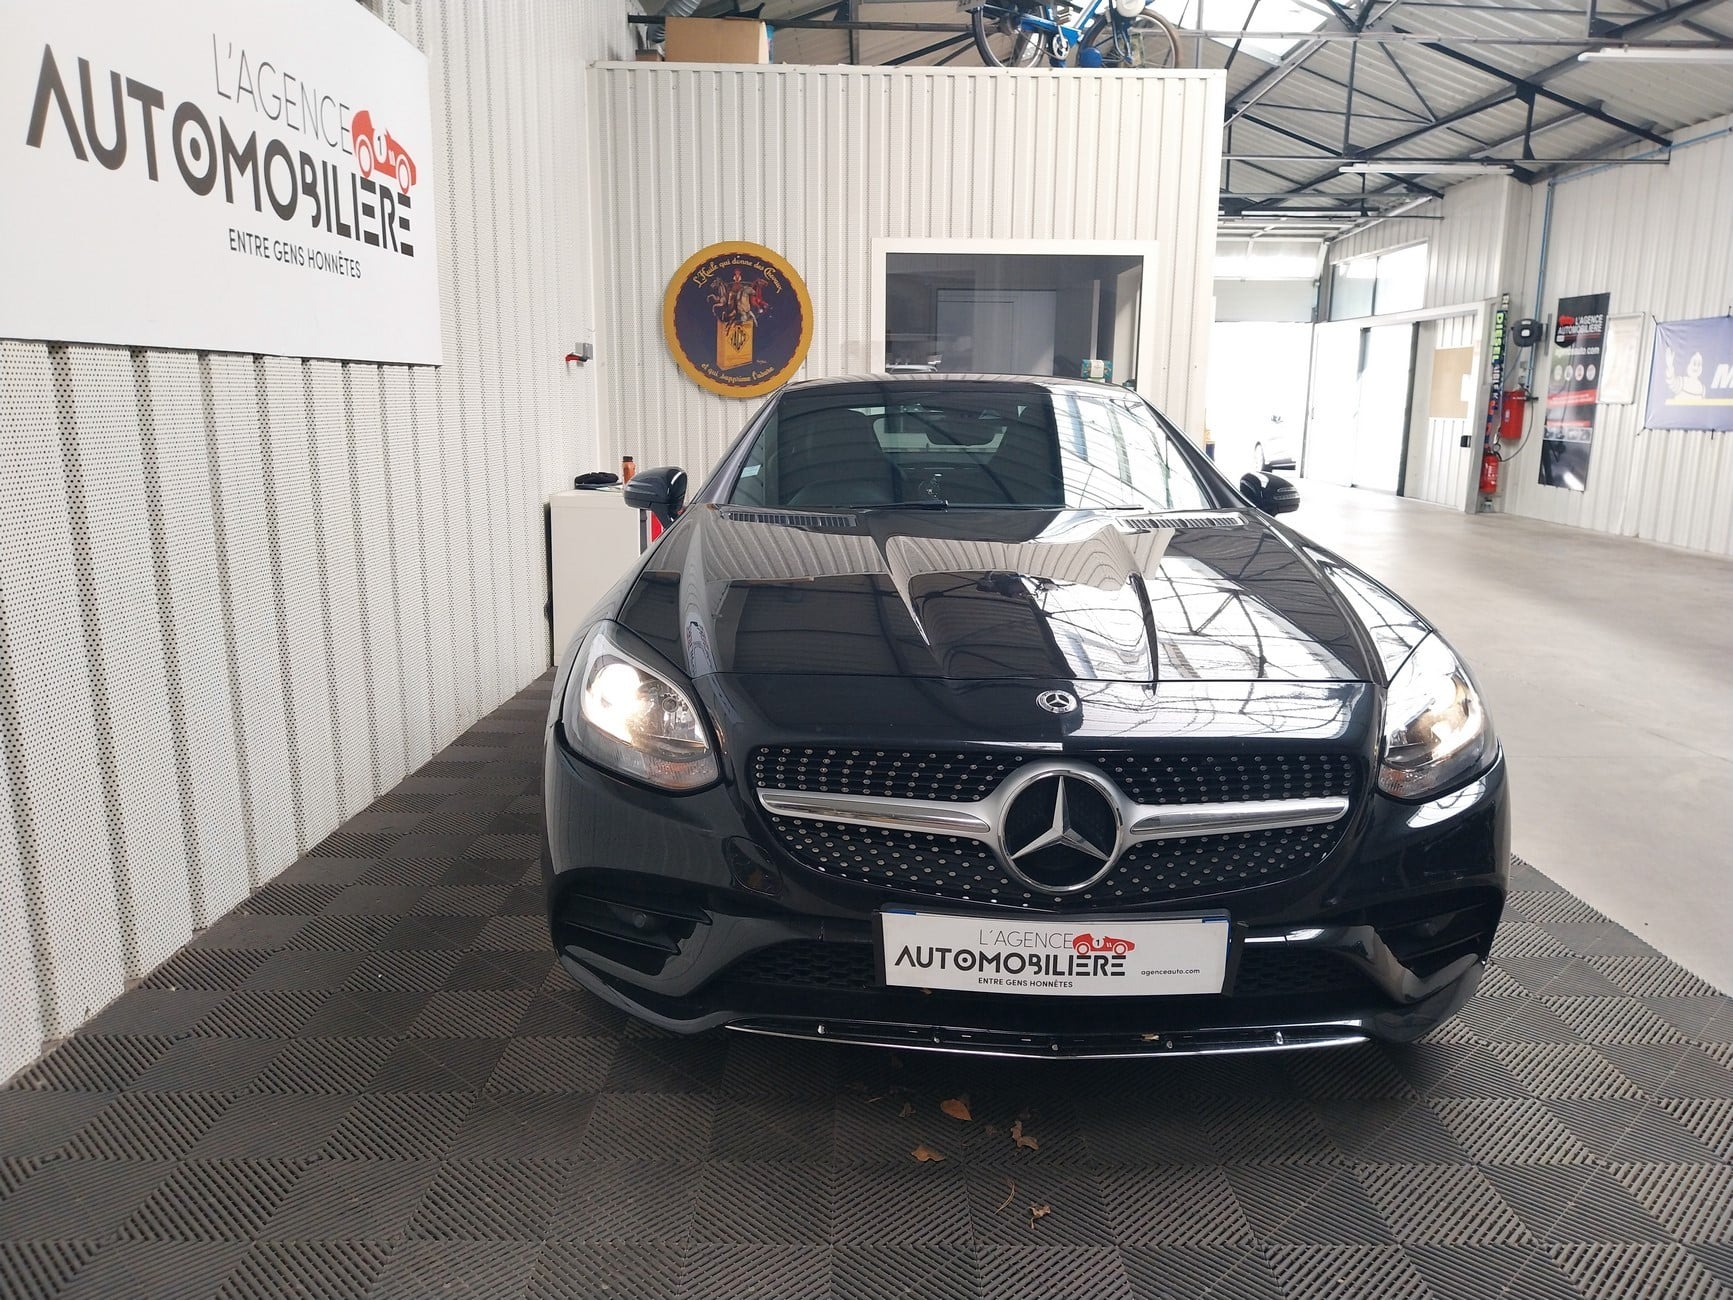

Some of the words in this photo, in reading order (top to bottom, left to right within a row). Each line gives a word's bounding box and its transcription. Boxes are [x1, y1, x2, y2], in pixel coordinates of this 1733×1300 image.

[213, 33, 353, 155] L'AGENCE
[26, 43, 415, 258] AUTOMOBILIERE
[229, 228, 271, 260] ENTRE
[273, 240, 305, 267] GENS
[308, 251, 362, 279] HONNÊTES
[719, 260, 731, 268] qui
[732, 257, 753, 265] donne
[753, 261, 765, 271] des
[1575, 314, 1603, 325] L'AGENCE
[1492, 312, 1504, 360] DIESEL
[707, 368, 719, 376] qui
[978, 929, 1073, 949] L'AGENCE
[894, 945, 1127, 977] AUTOMOBILIERE
[978, 977, 1003, 986] ENTRE
[1005, 979, 1028, 987] GENS
[1029, 978, 1073, 988] HONNÊTES
[1141, 968, 1200, 977] agenceauto.com
